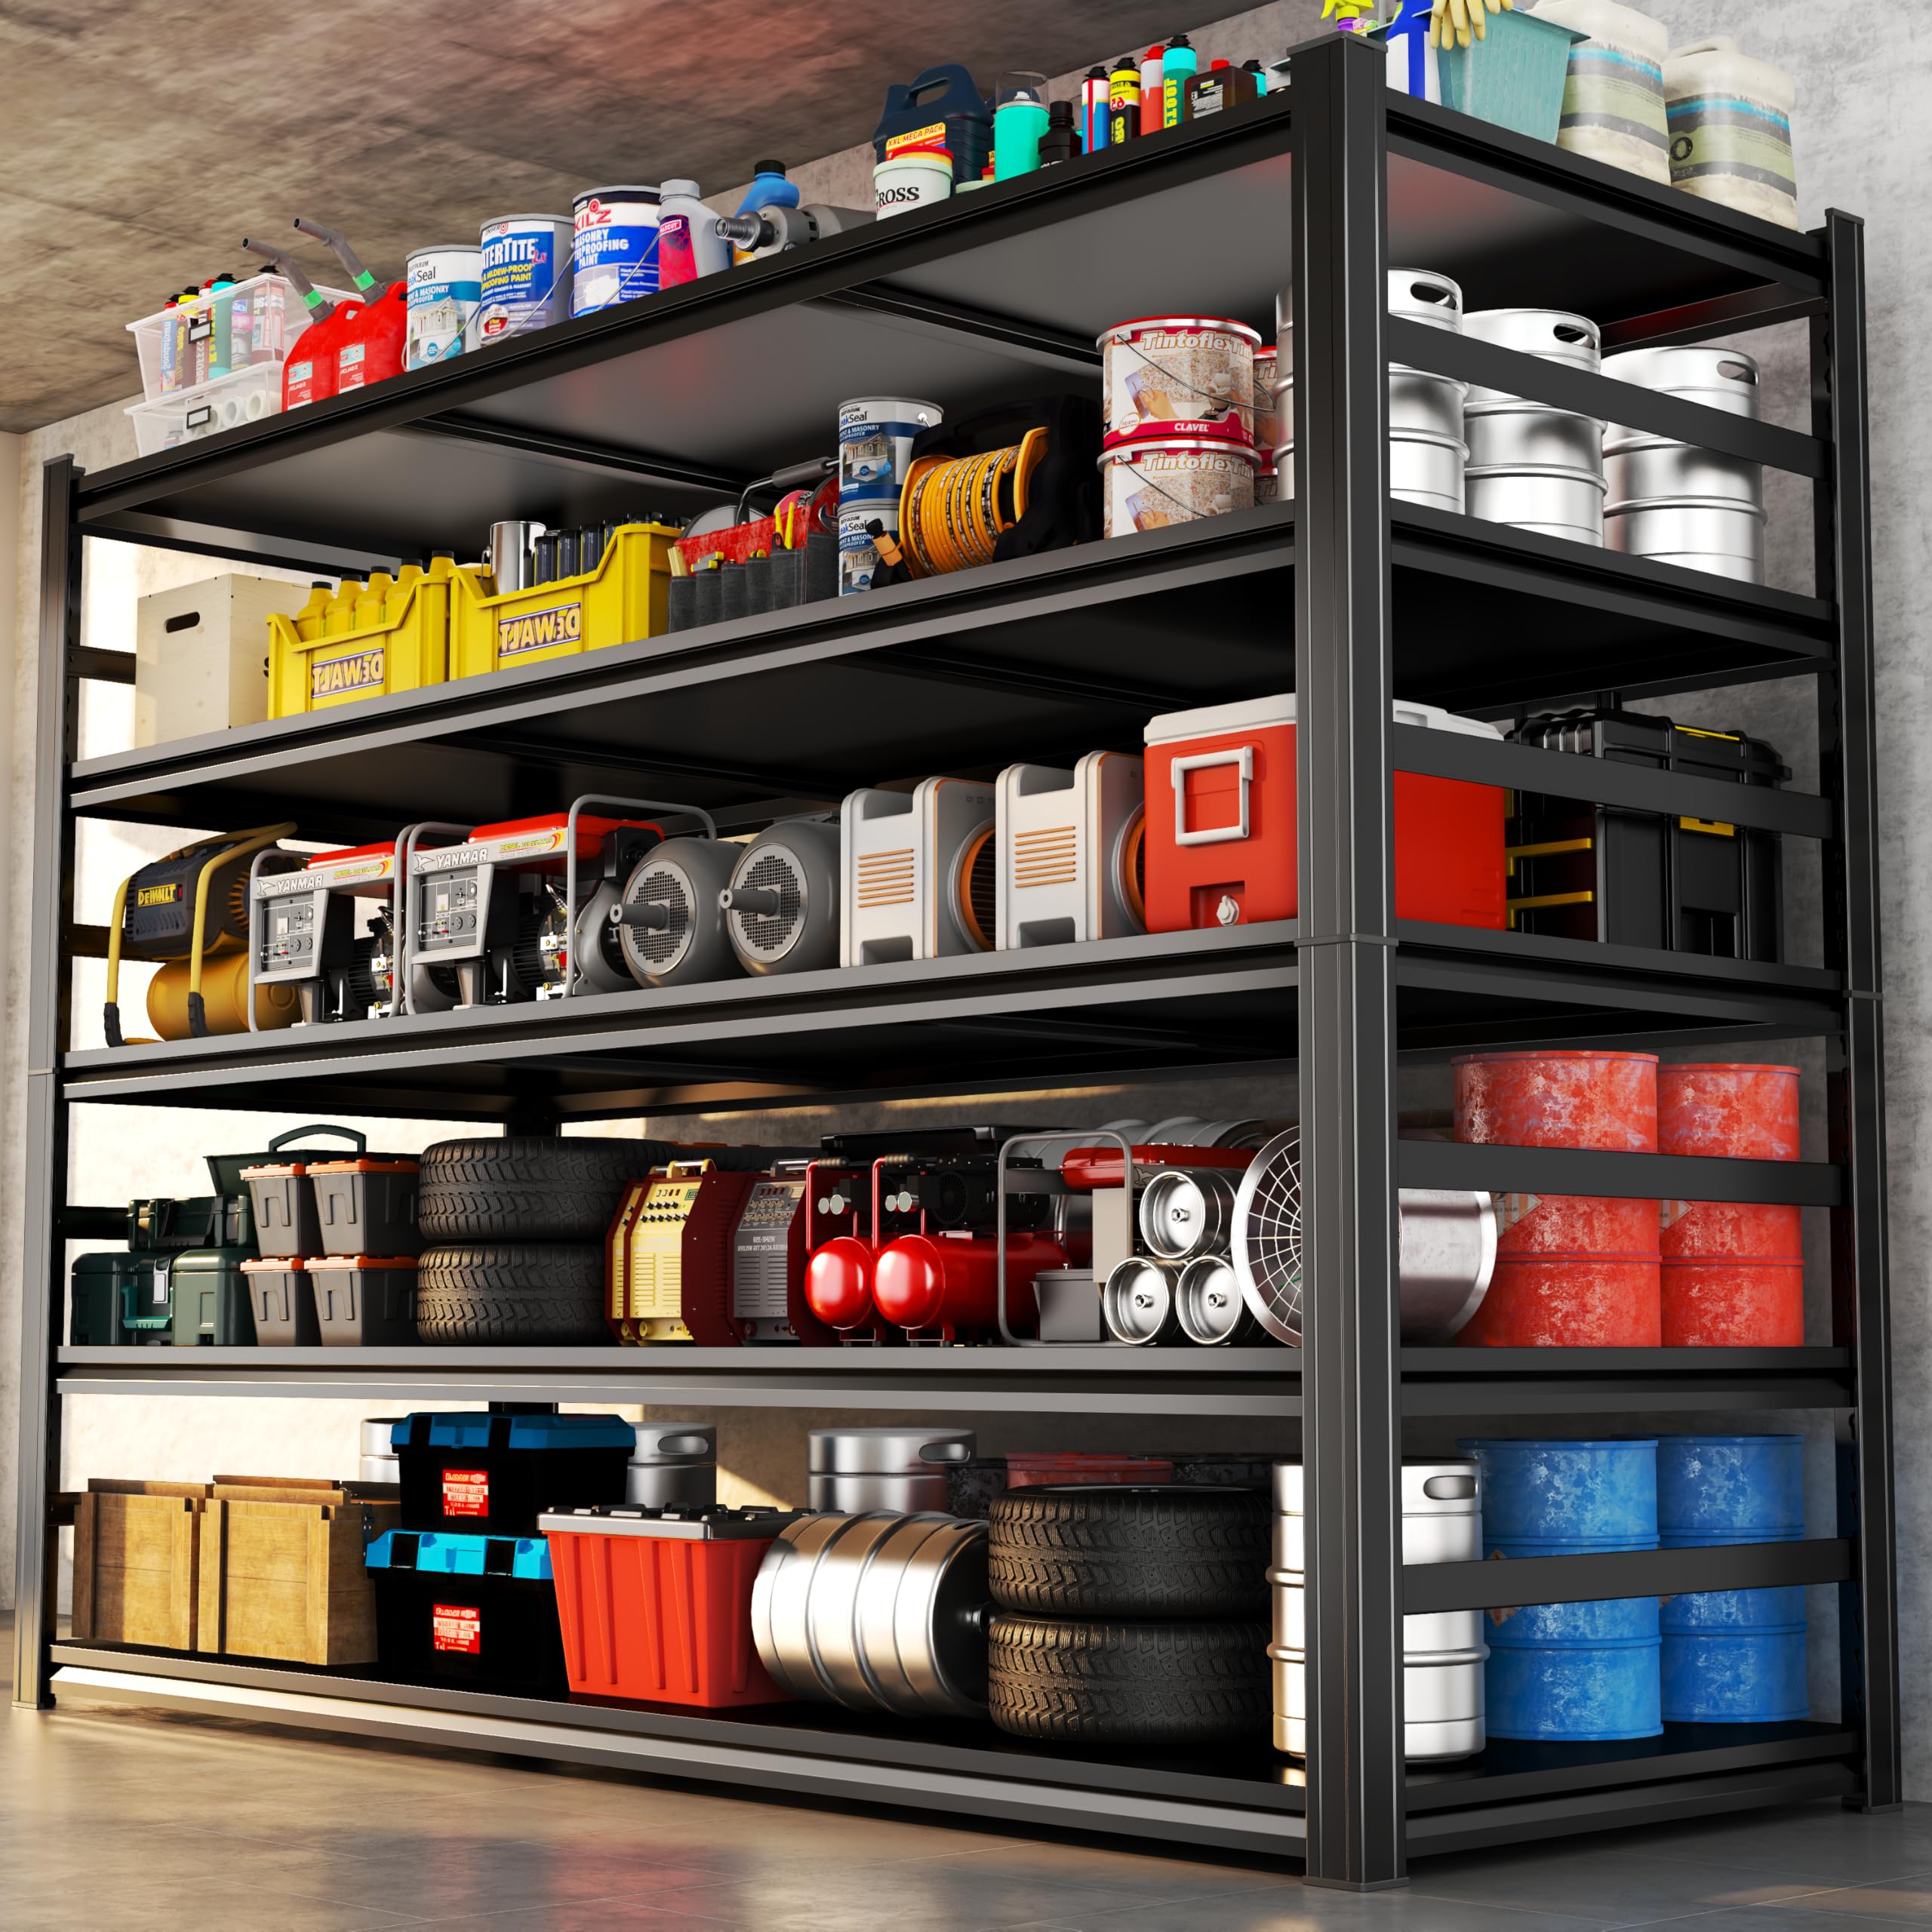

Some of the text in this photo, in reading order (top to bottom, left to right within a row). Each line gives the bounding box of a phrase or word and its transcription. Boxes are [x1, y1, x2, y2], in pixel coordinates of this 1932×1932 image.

[888, 138, 901, 147] XXL
[903, 131, 922, 142] MEGA
[924, 123, 943, 135] PACK
[574, 228, 610, 249] MASONRY
[579, 253, 598, 269] PAINT
[511, 272, 531, 282] PAINT
[420, 285, 449, 297] MASONRY
[1140, 330, 1232, 351] Tintoflex
[851, 424, 880, 432] MASONRY
[1174, 423, 1208, 432] CLAVEL
[1140, 451, 1232, 472] Tintoflex
[436, 848, 488, 869] YANMAR
[277, 874, 324, 894] YANMAR
